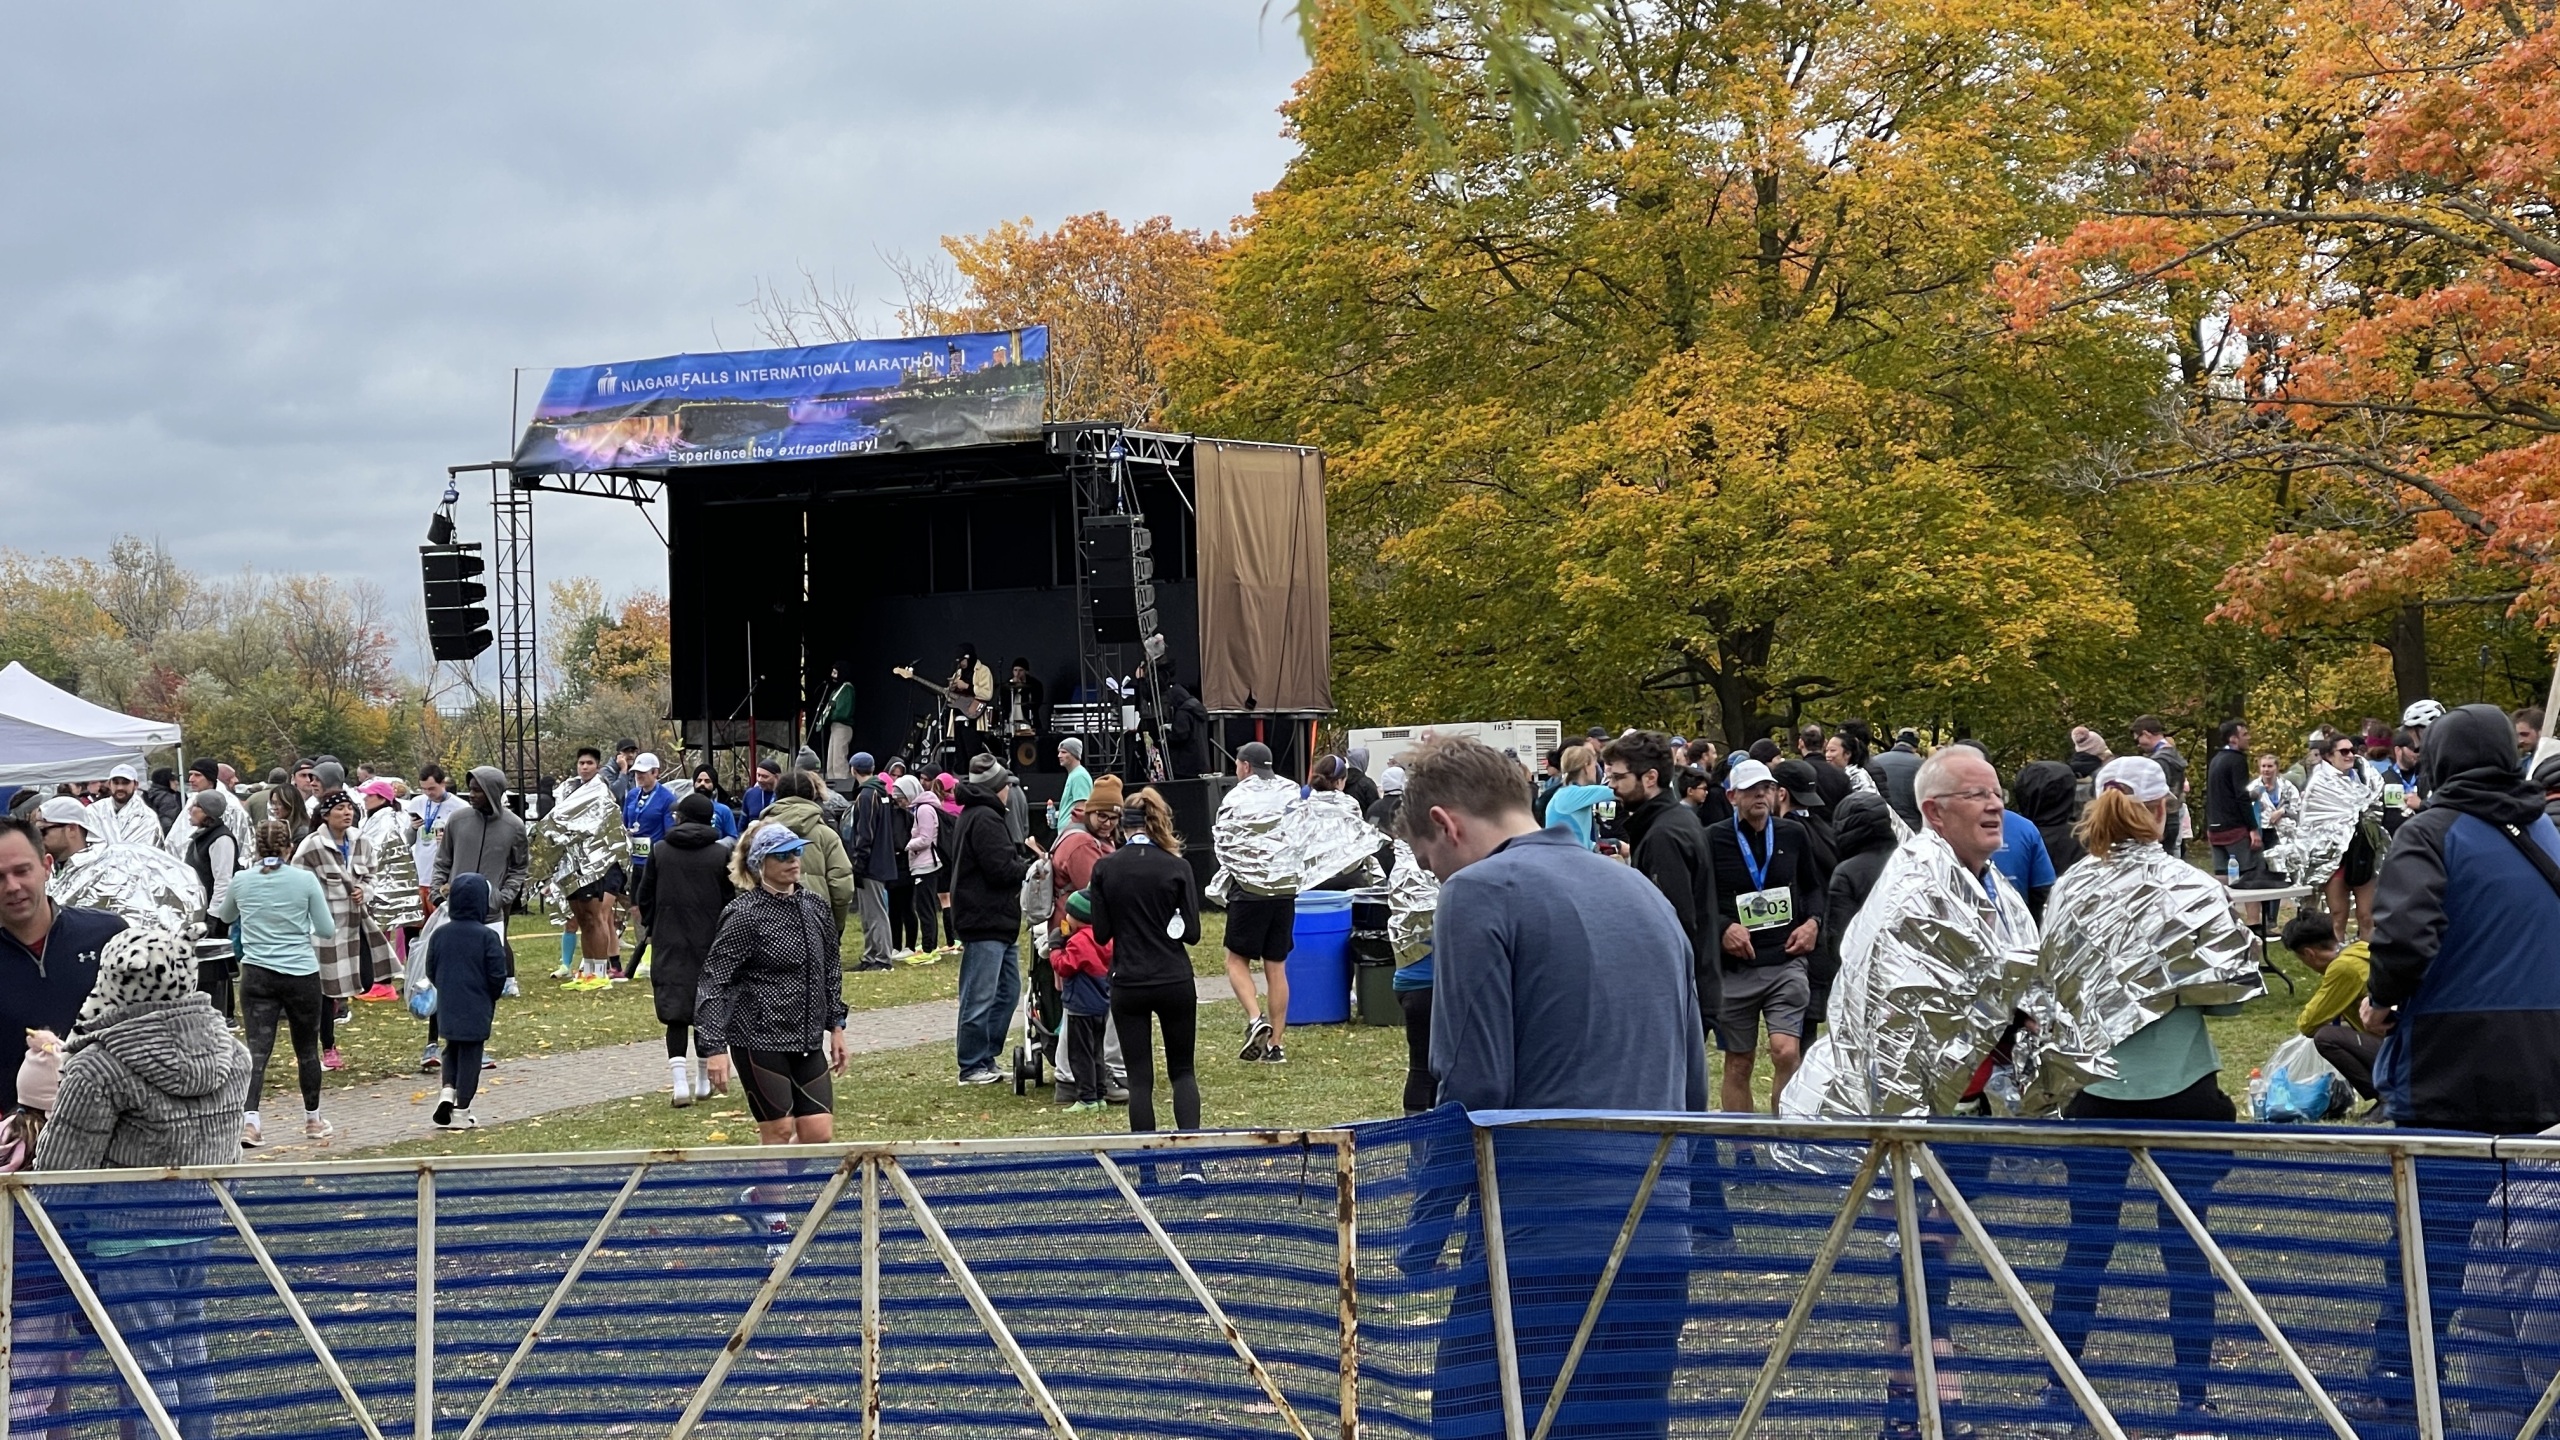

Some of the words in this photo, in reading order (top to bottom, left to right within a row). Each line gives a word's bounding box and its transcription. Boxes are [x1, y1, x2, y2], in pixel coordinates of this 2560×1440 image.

[621, 374, 679, 393] NIAGARA
[681, 370, 729, 386] FALLS
[735, 361, 850, 383] INTERNATIONAL
[855, 354, 945, 372] MARATHON
[668, 447, 747, 464] Experience
[752, 446, 773, 458] the
[779, 437, 878, 456] extraordinary!
[1743, 899, 1789, 919] 103
